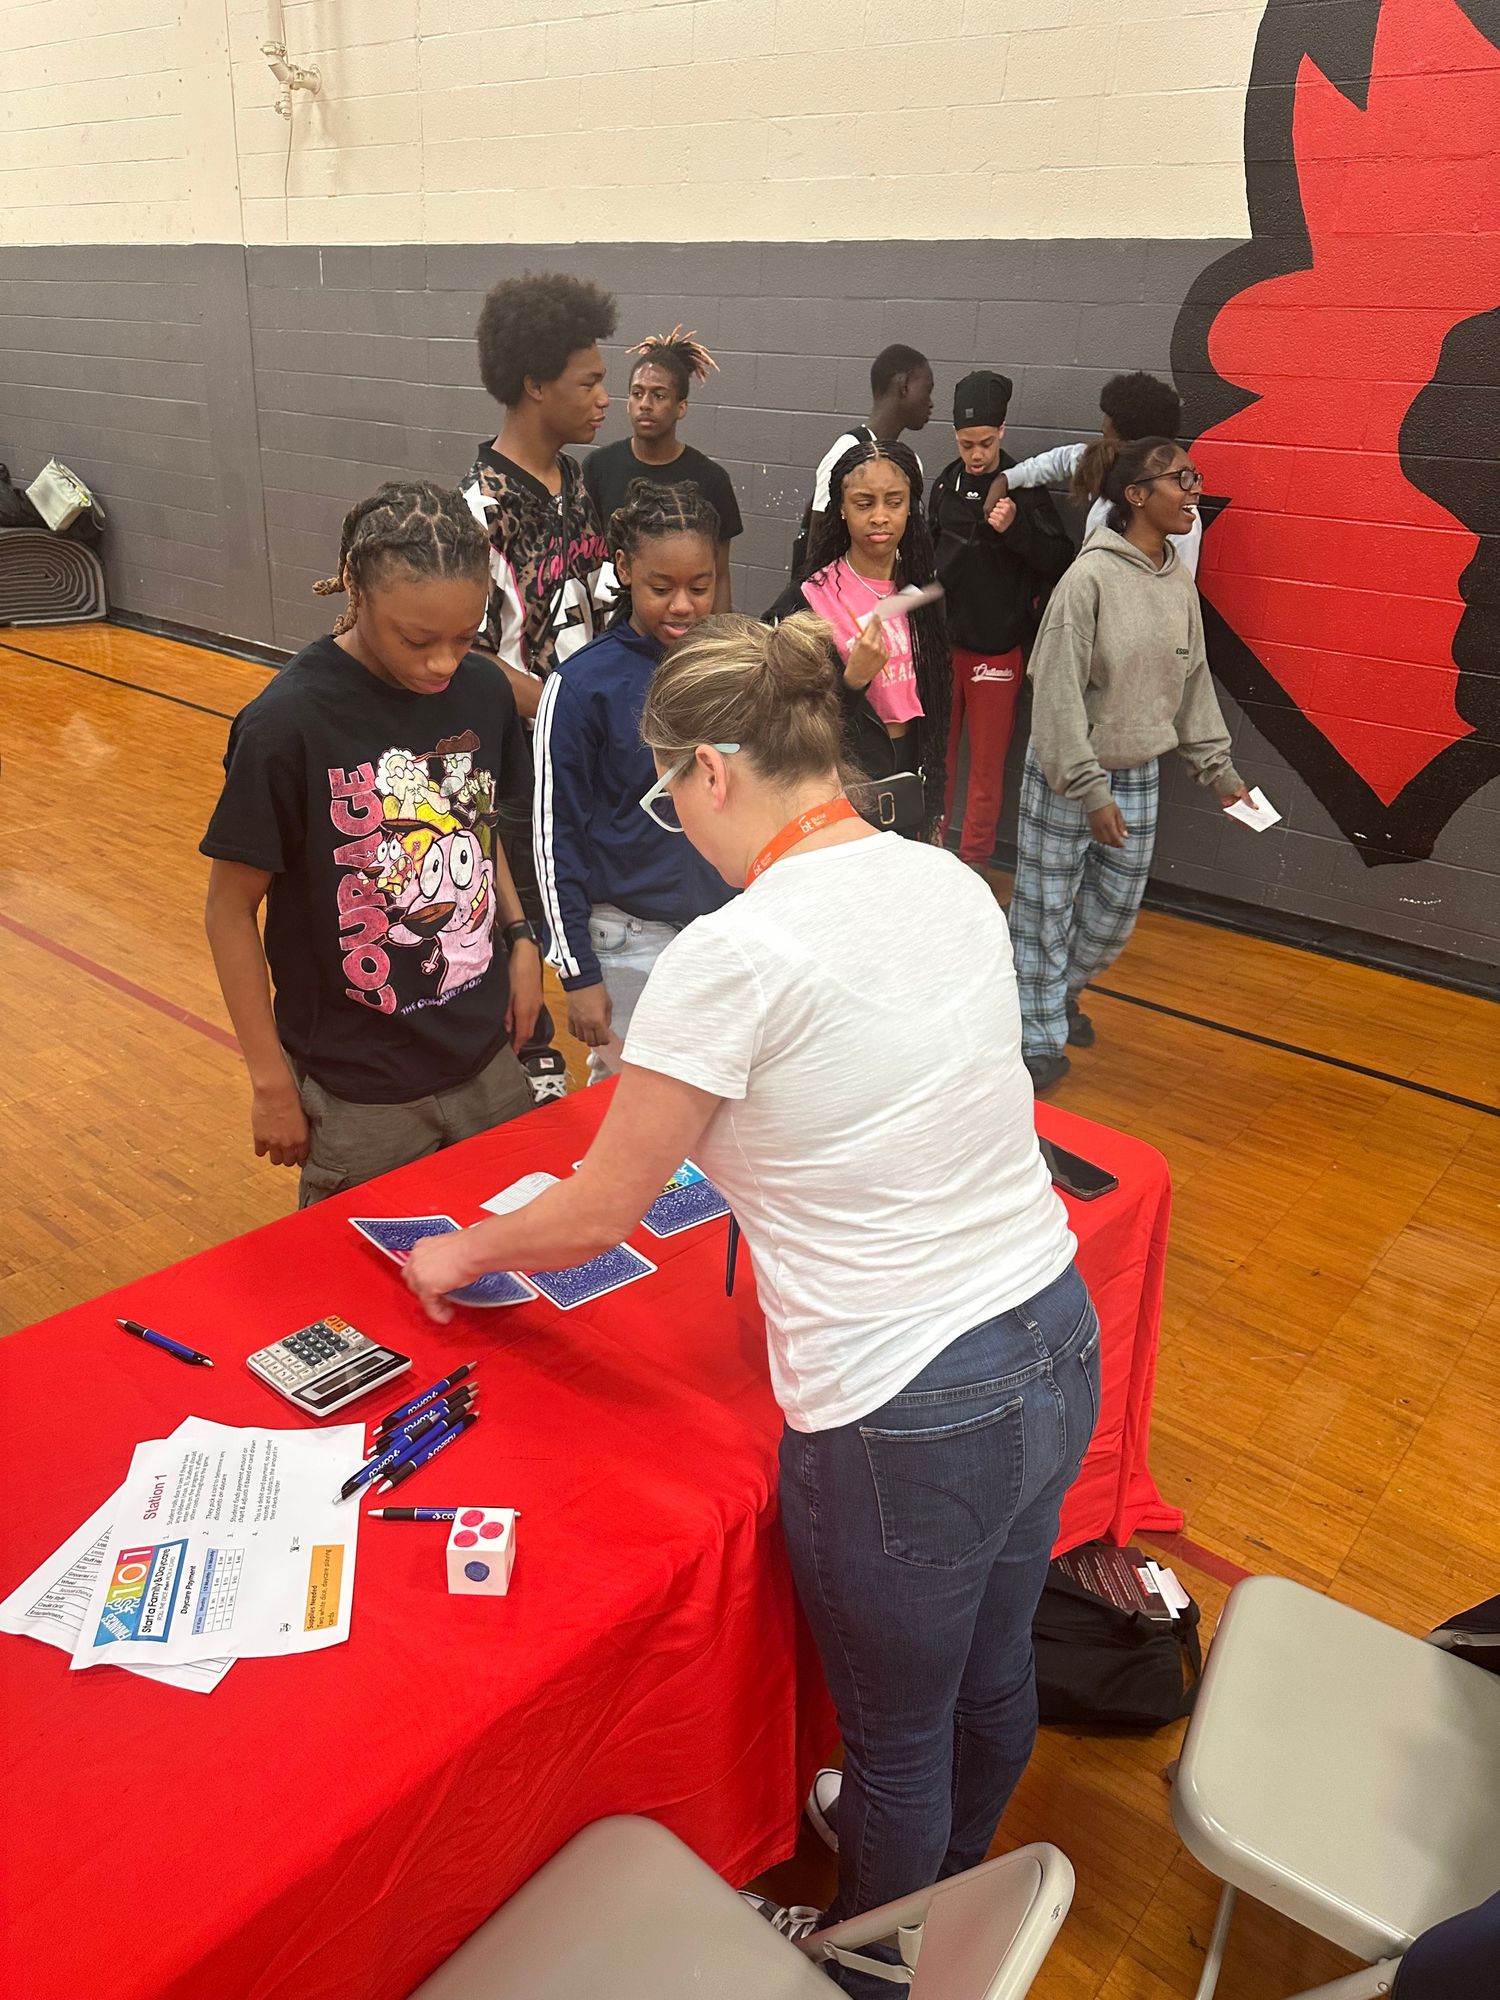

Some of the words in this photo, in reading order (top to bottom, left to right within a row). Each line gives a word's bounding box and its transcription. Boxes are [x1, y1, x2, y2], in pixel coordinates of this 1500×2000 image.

[328, 762, 397, 1015] COURAGE
[401, 1002, 416, 1016] THE
[265, 1440, 273, 1455] student
[239, 1454, 247, 1471] amount
[236, 1472, 245, 1491] payment
[143, 1482, 165, 1520] Station
[214, 1499, 223, 1520] discounts
[220, 1474, 228, 1490] daycare
[233, 1492, 241, 1503] finds
[241, 1489, 249, 1505] adjusts
[177, 1499, 185, 1515] children
[206, 1509, 214, 1520] They
[230, 1504, 239, 1523] Student
[262, 1505, 270, 1521] records
[167, 1510, 175, 1526] Student
[112, 1550, 151, 1598] 101
[186, 1566, 197, 1590] Payment
[321, 1568, 330, 1587] daycare
[141, 1616, 154, 1634] Start
[148, 1584, 163, 1608] Family
[156, 1549, 171, 1578] Daycare
[309, 1585, 318, 1606] Needed
[181, 1592, 193, 1615] Daycare
[318, 1602, 326, 1616] white
[306, 1607, 317, 1630] Supplies
